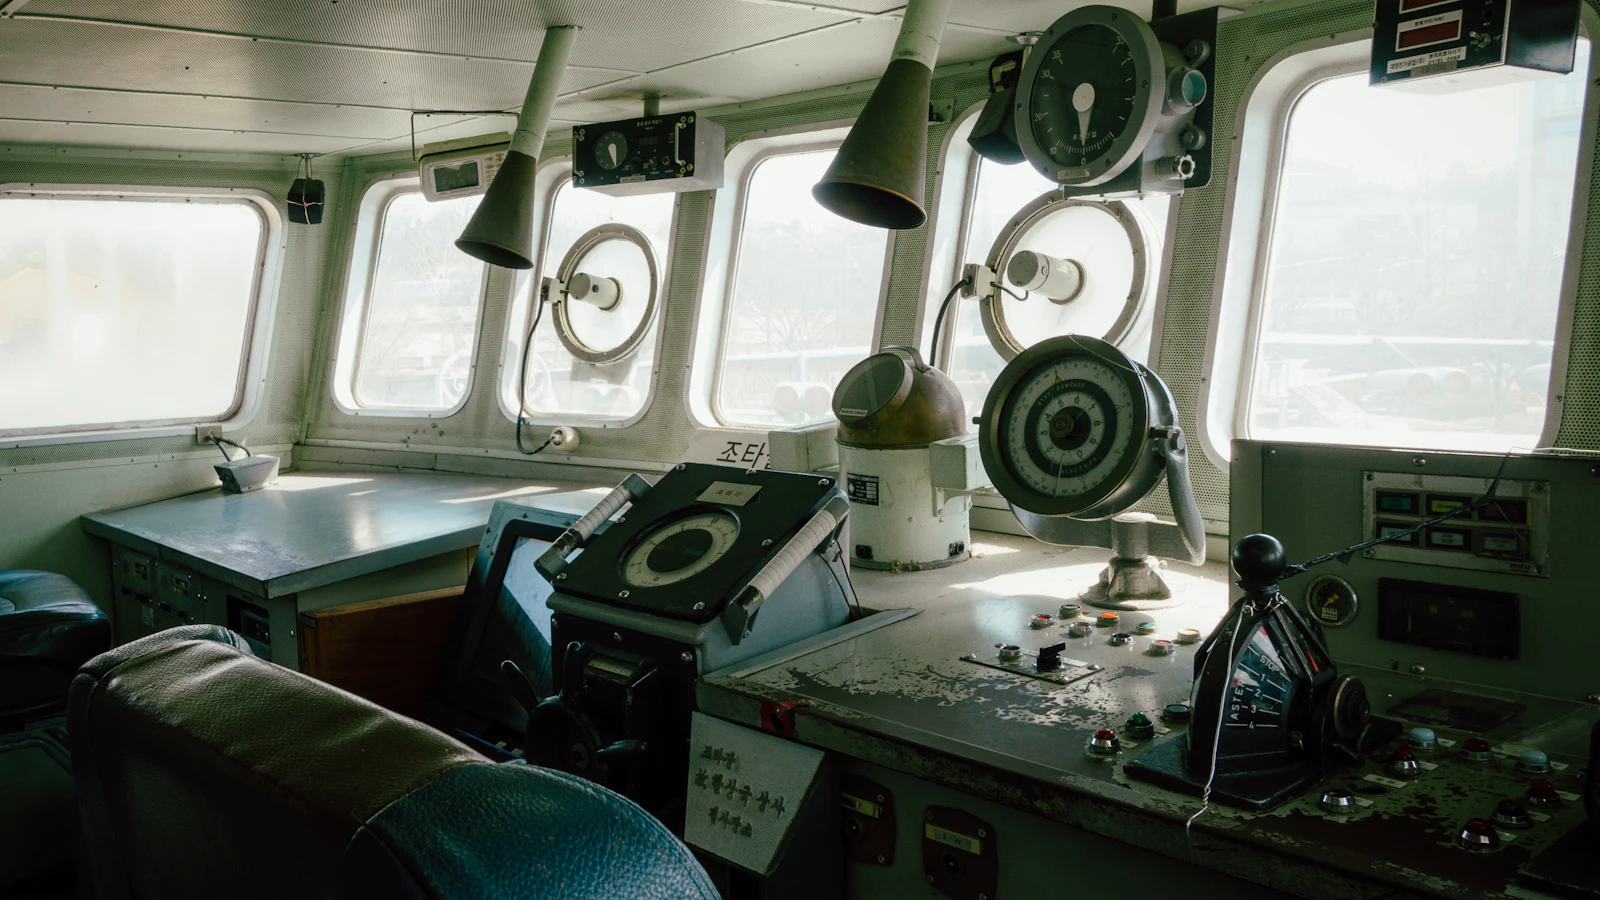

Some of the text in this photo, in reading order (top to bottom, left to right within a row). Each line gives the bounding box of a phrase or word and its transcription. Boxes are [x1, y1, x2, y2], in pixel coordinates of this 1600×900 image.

[1052, 50, 1060, 59] 35
[1041, 70, 1050, 78] 30
[1034, 112, 1042, 121] 20
[1050, 148, 1056, 156] 10
[1080, 157, 1086, 166] 0
[1056, 382, 1085, 390] COMPASS
[1260, 654, 1280, 672] STOP
[1261, 674, 1266, 682] 1
[1230, 672, 1248, 720] ASTERN
[1254, 688, 1261, 698] 2
[1250, 704, 1256, 714] 3
[1249, 720, 1254, 729] 4
[756, 790, 786, 820] 상사
